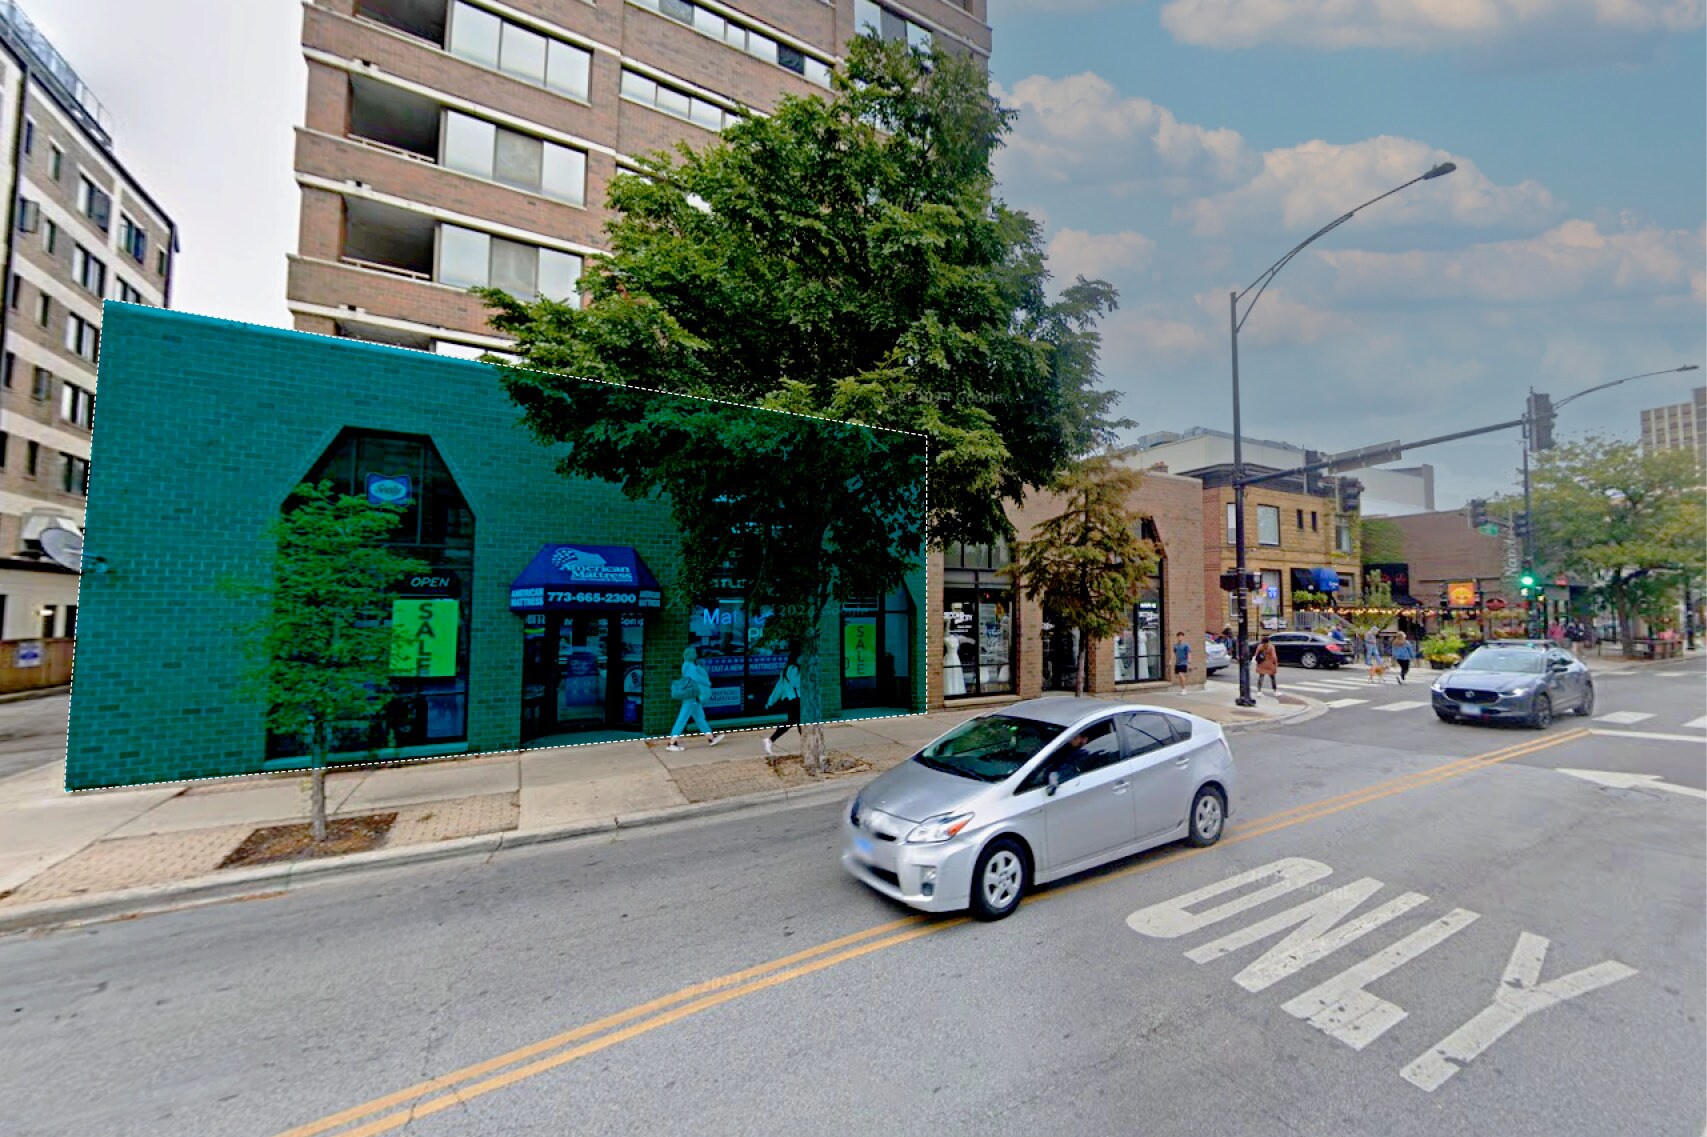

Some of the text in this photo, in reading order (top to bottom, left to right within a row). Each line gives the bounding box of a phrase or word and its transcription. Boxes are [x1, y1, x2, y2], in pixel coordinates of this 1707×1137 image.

[560, 563, 630, 572] American
[572, 571, 632, 580] Mattress
[410, 577, 450, 588] OPEN
[547, 591, 636, 603] 773-665-2300
[416, 603, 436, 675] SALE
[856, 624, 865, 675] SALE
[1126, 856, 1639, 1093] ONLY
